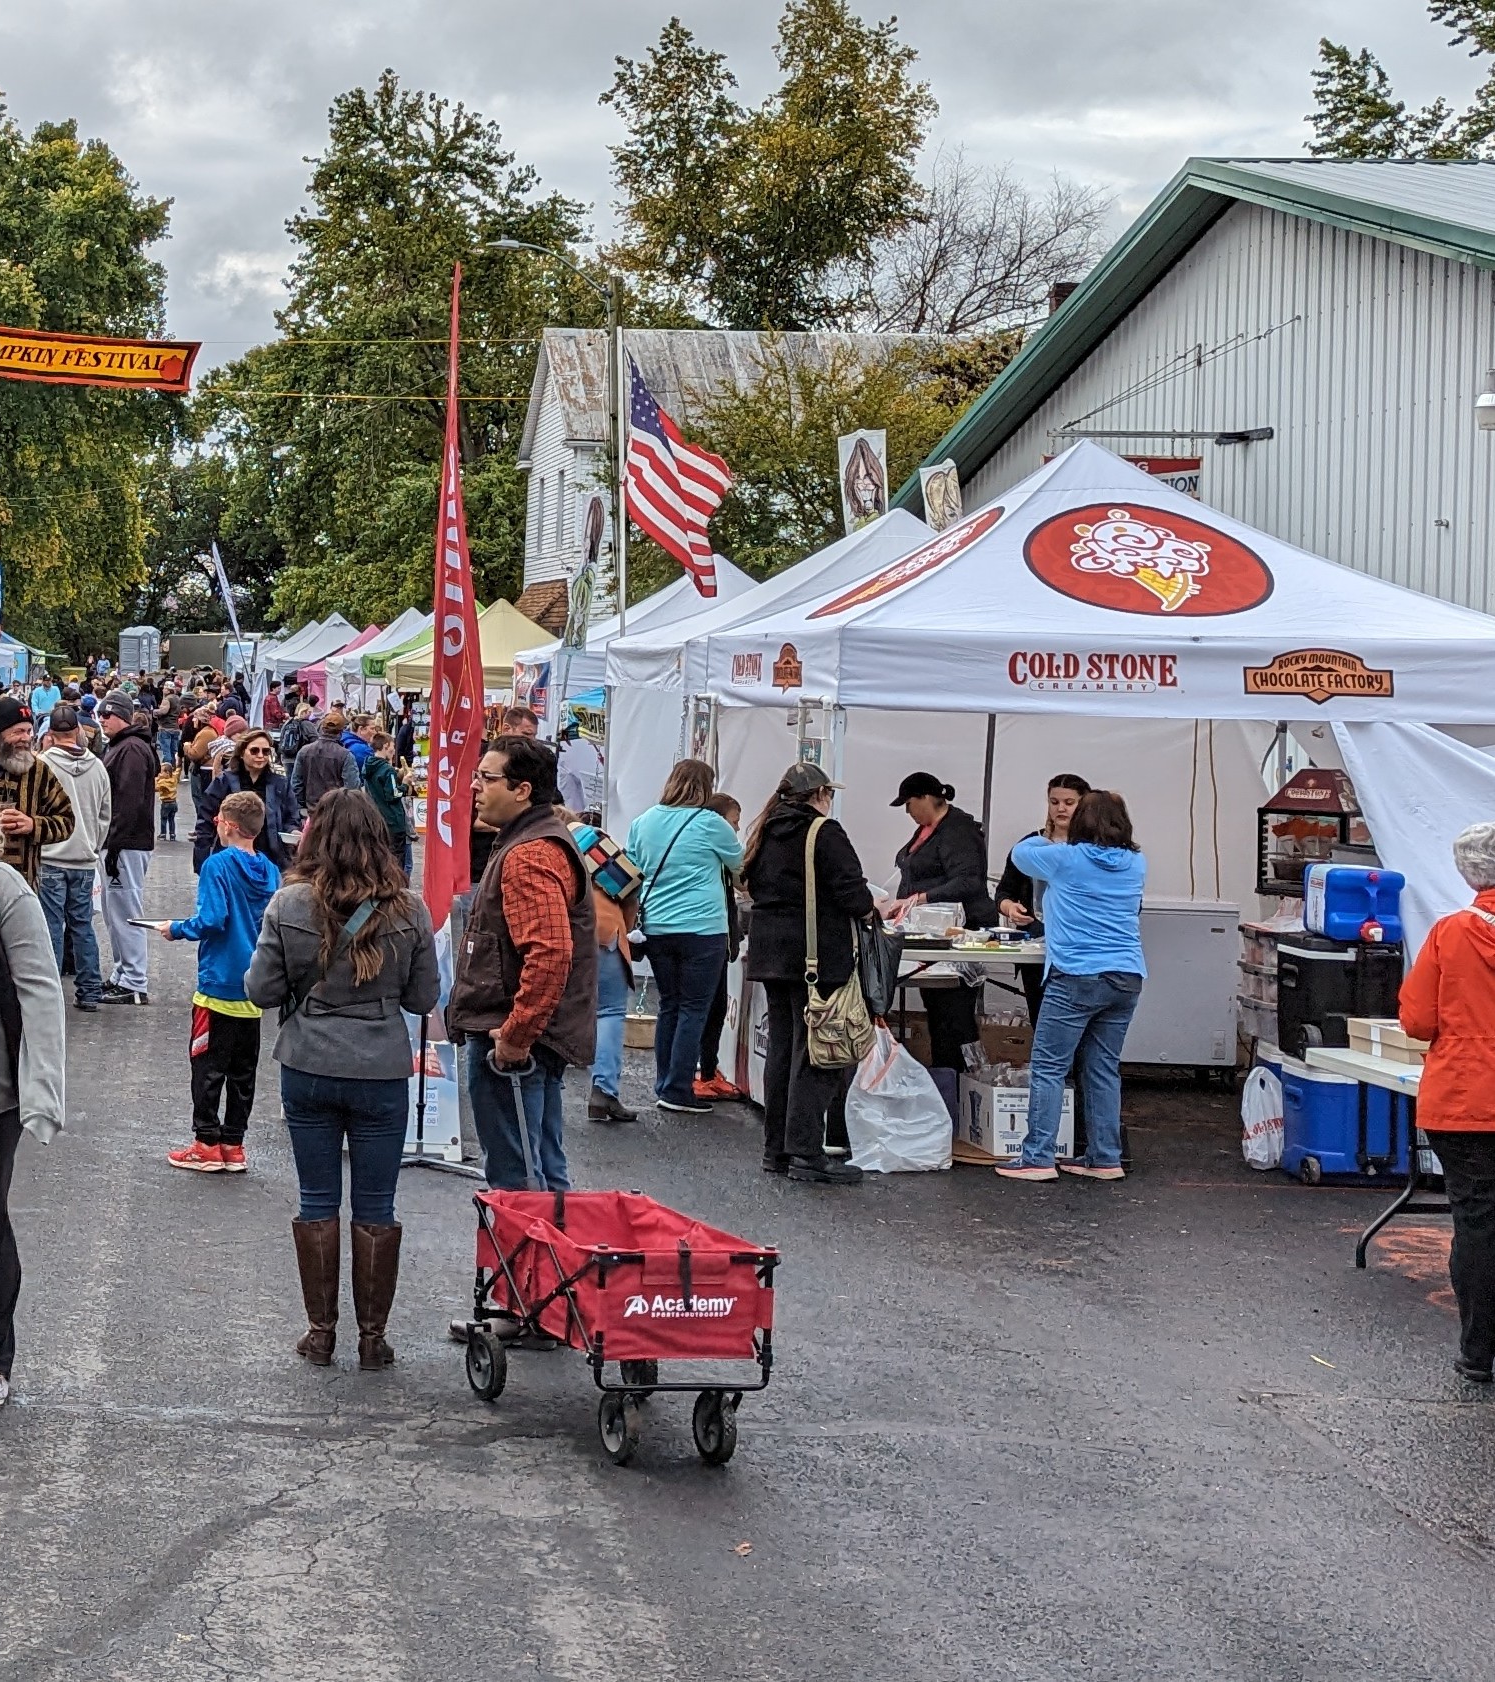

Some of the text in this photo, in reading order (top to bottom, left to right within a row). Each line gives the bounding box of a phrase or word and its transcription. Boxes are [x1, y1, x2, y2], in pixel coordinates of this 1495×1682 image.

[61, 349, 166, 372] FESTIVAL
[1008, 651, 1178, 687] COLD STONE
[1278, 653, 1357, 672] ROCKY MOUNTAIN
[1037, 682, 1148, 691] CREAMERY
[1253, 672, 1383, 692] CHOCOLATE FACTORY
